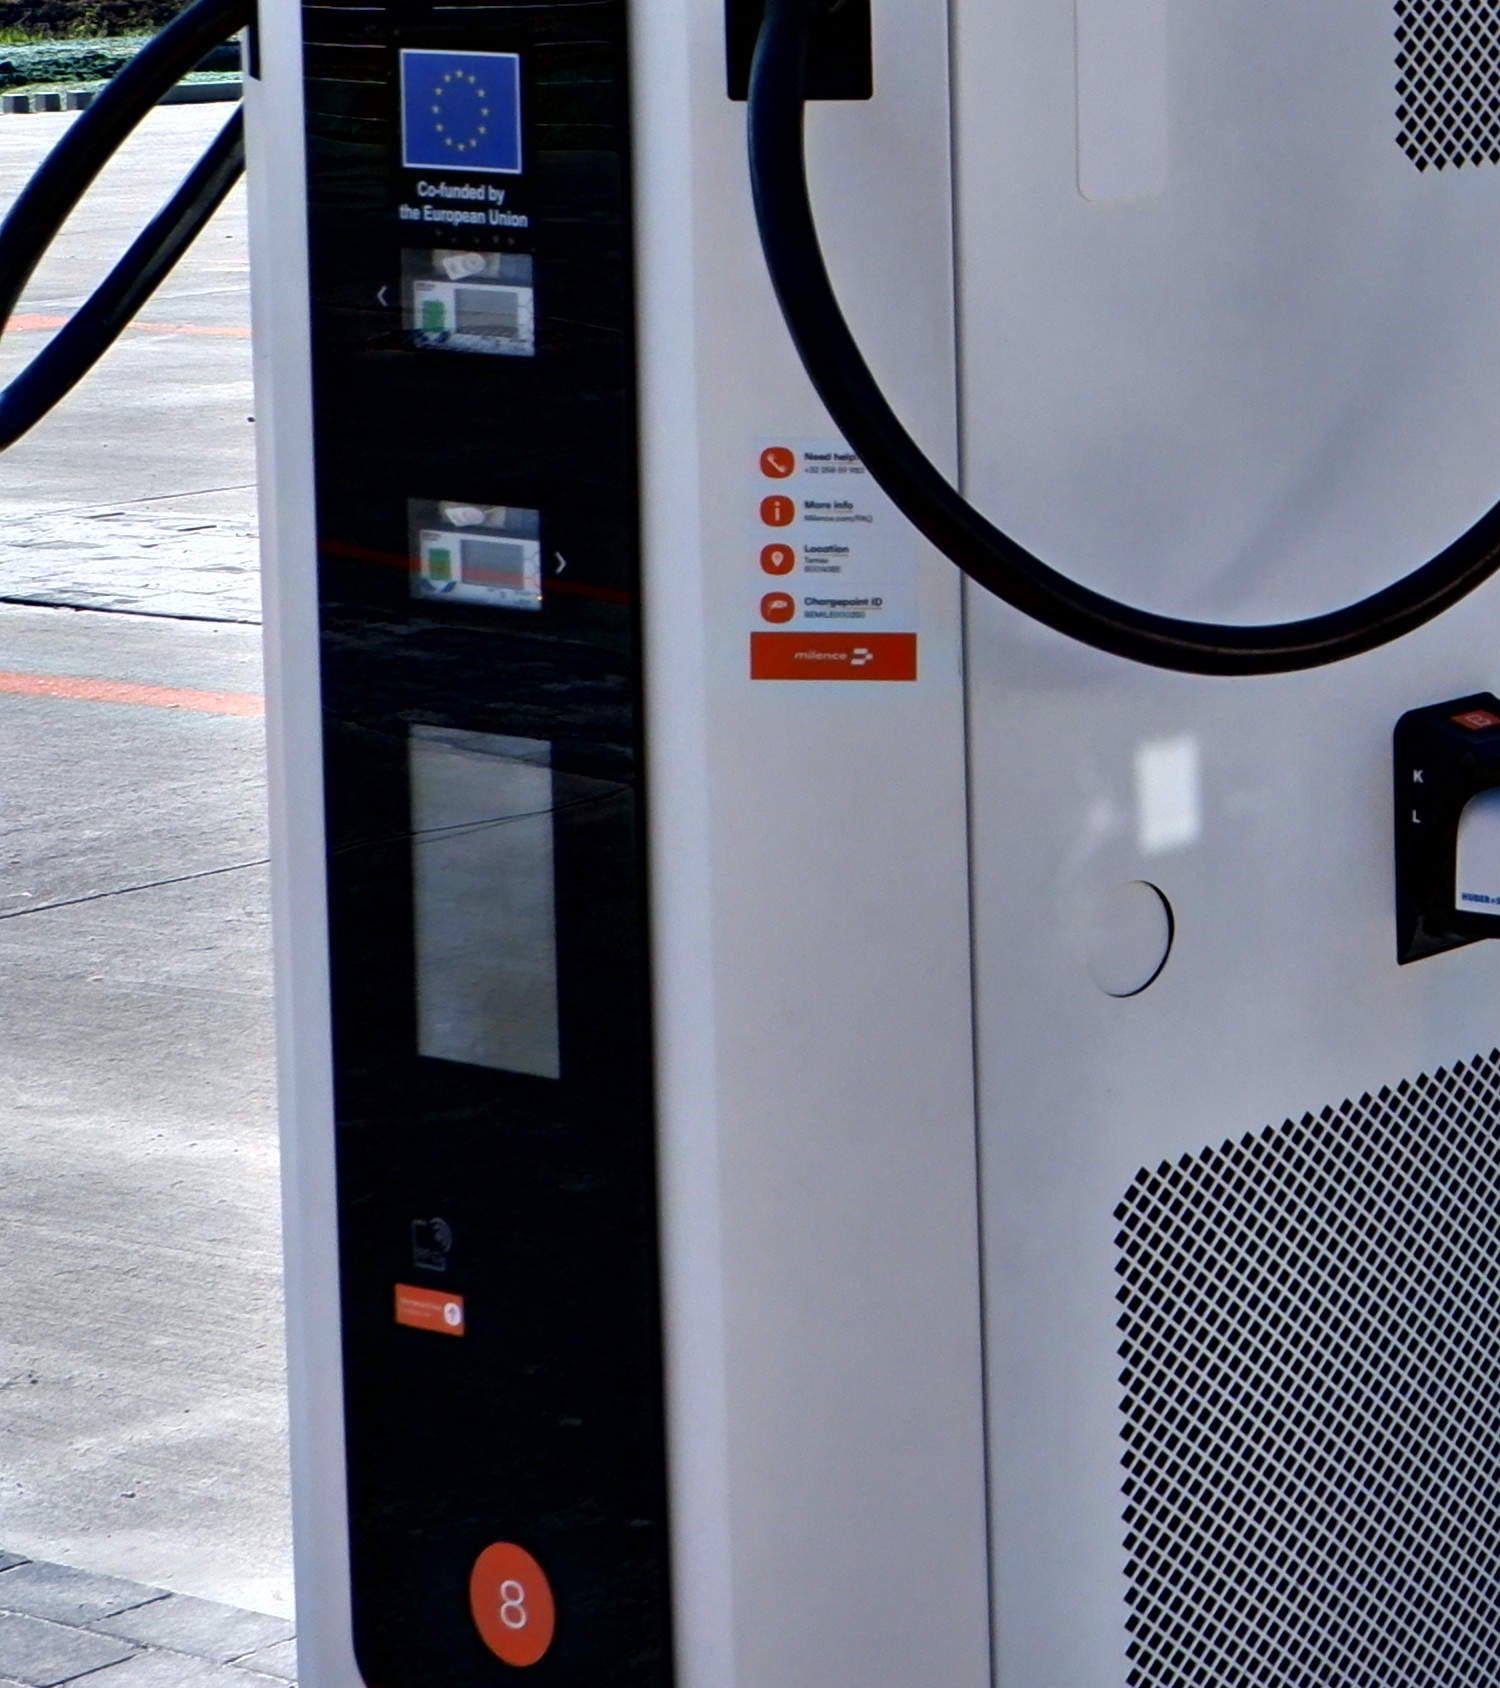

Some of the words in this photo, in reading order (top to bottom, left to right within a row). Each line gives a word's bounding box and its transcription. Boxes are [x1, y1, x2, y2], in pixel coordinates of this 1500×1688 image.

[417, 180, 485, 202] Co-funded
[488, 184, 505, 206] by
[399, 204, 421, 221] the
[423, 205, 486, 226] European
[489, 209, 529, 229] Union
[804, 452, 832, 461] Need
[804, 500, 831, 509] More
[833, 500, 854, 509] info
[804, 544, 849, 553] Location
[804, 596, 868, 608] Chargepoint
[871, 597, 883, 607] ID
[793, 650, 848, 660] milence
[1413, 768, 1424, 784] K
[1412, 809, 1421, 824] L
[500, 1579, 526, 1629] 8
